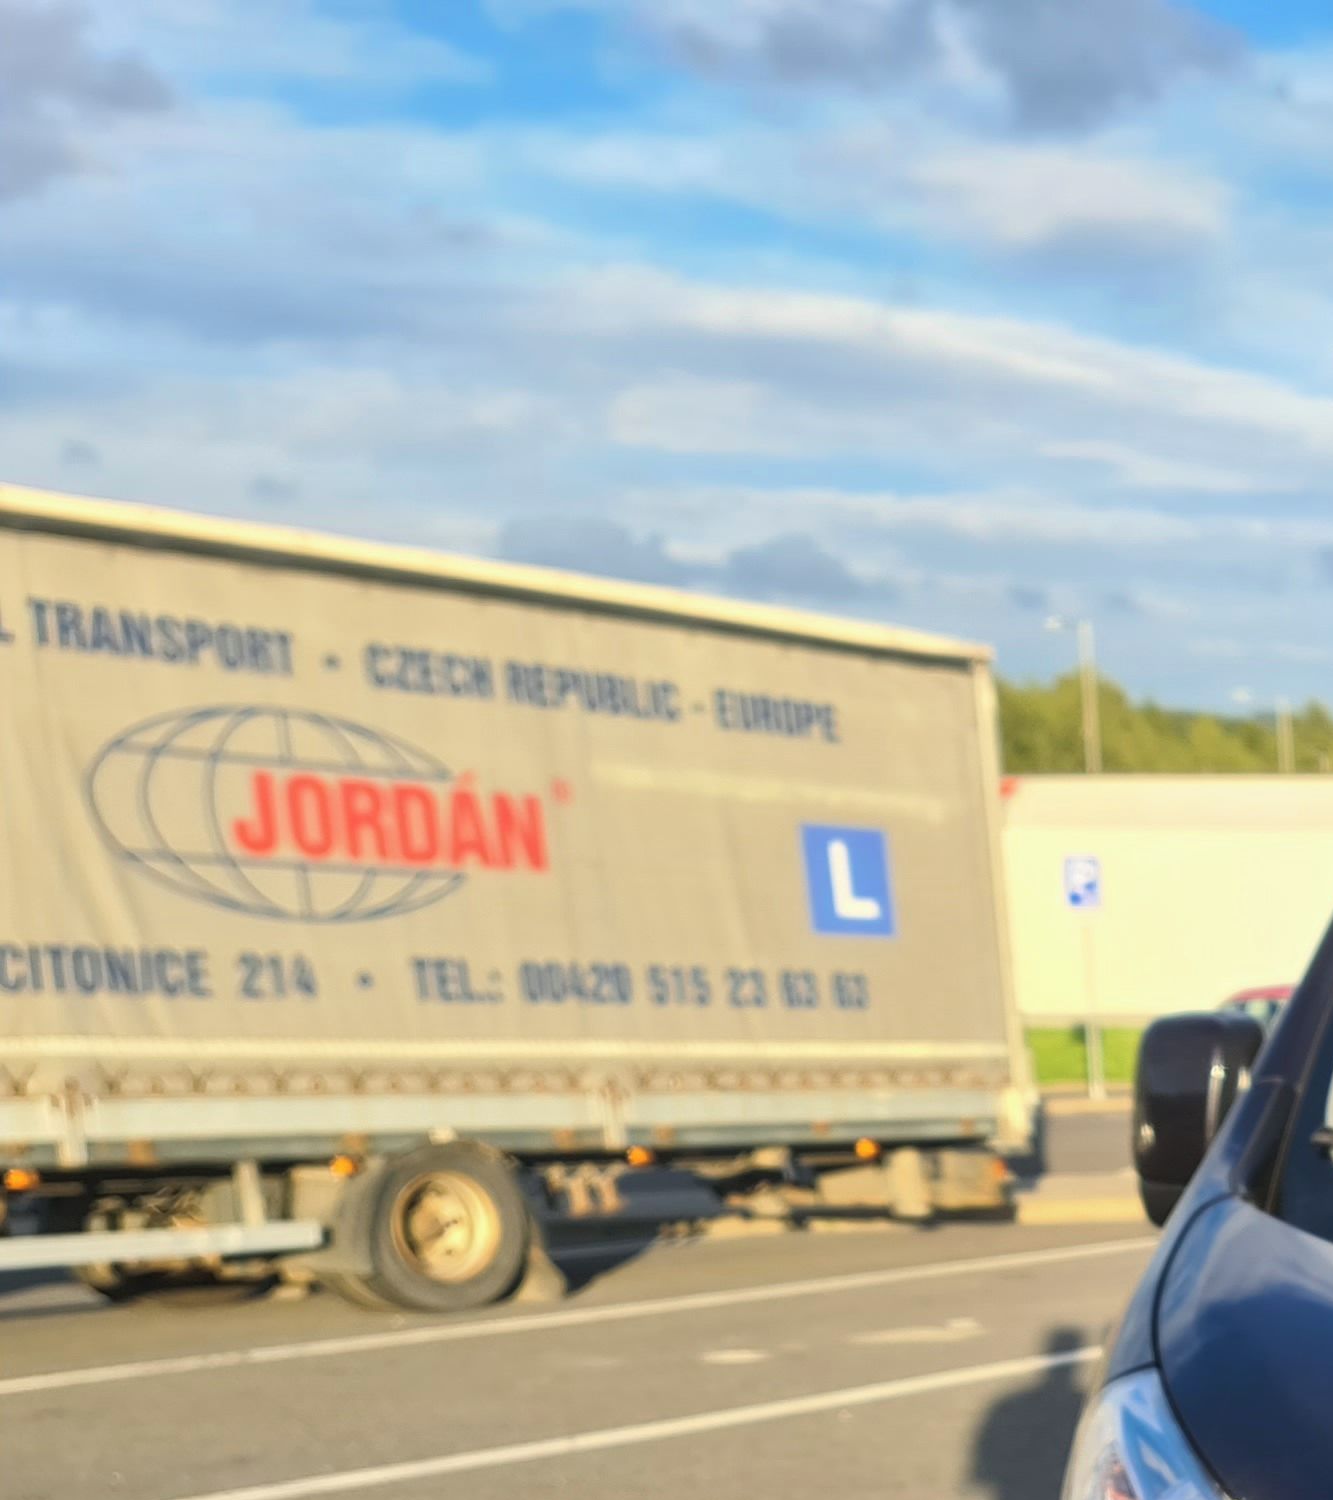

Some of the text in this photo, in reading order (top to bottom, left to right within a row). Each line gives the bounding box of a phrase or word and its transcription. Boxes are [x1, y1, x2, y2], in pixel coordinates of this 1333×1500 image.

[27, 595, 294, 676] TRANSPORT
[363, 642, 495, 699] CZECH
[505, 660, 682, 723] REPUBLIC
[714, 687, 841, 744] EUROPE
[232, 769, 550, 874] JORDÁN
[239, 952, 318, 999] 214
[519, 959, 635, 1006] 00420
[646, 963, 712, 1008] 515
[727, 967, 769, 1009] 23
